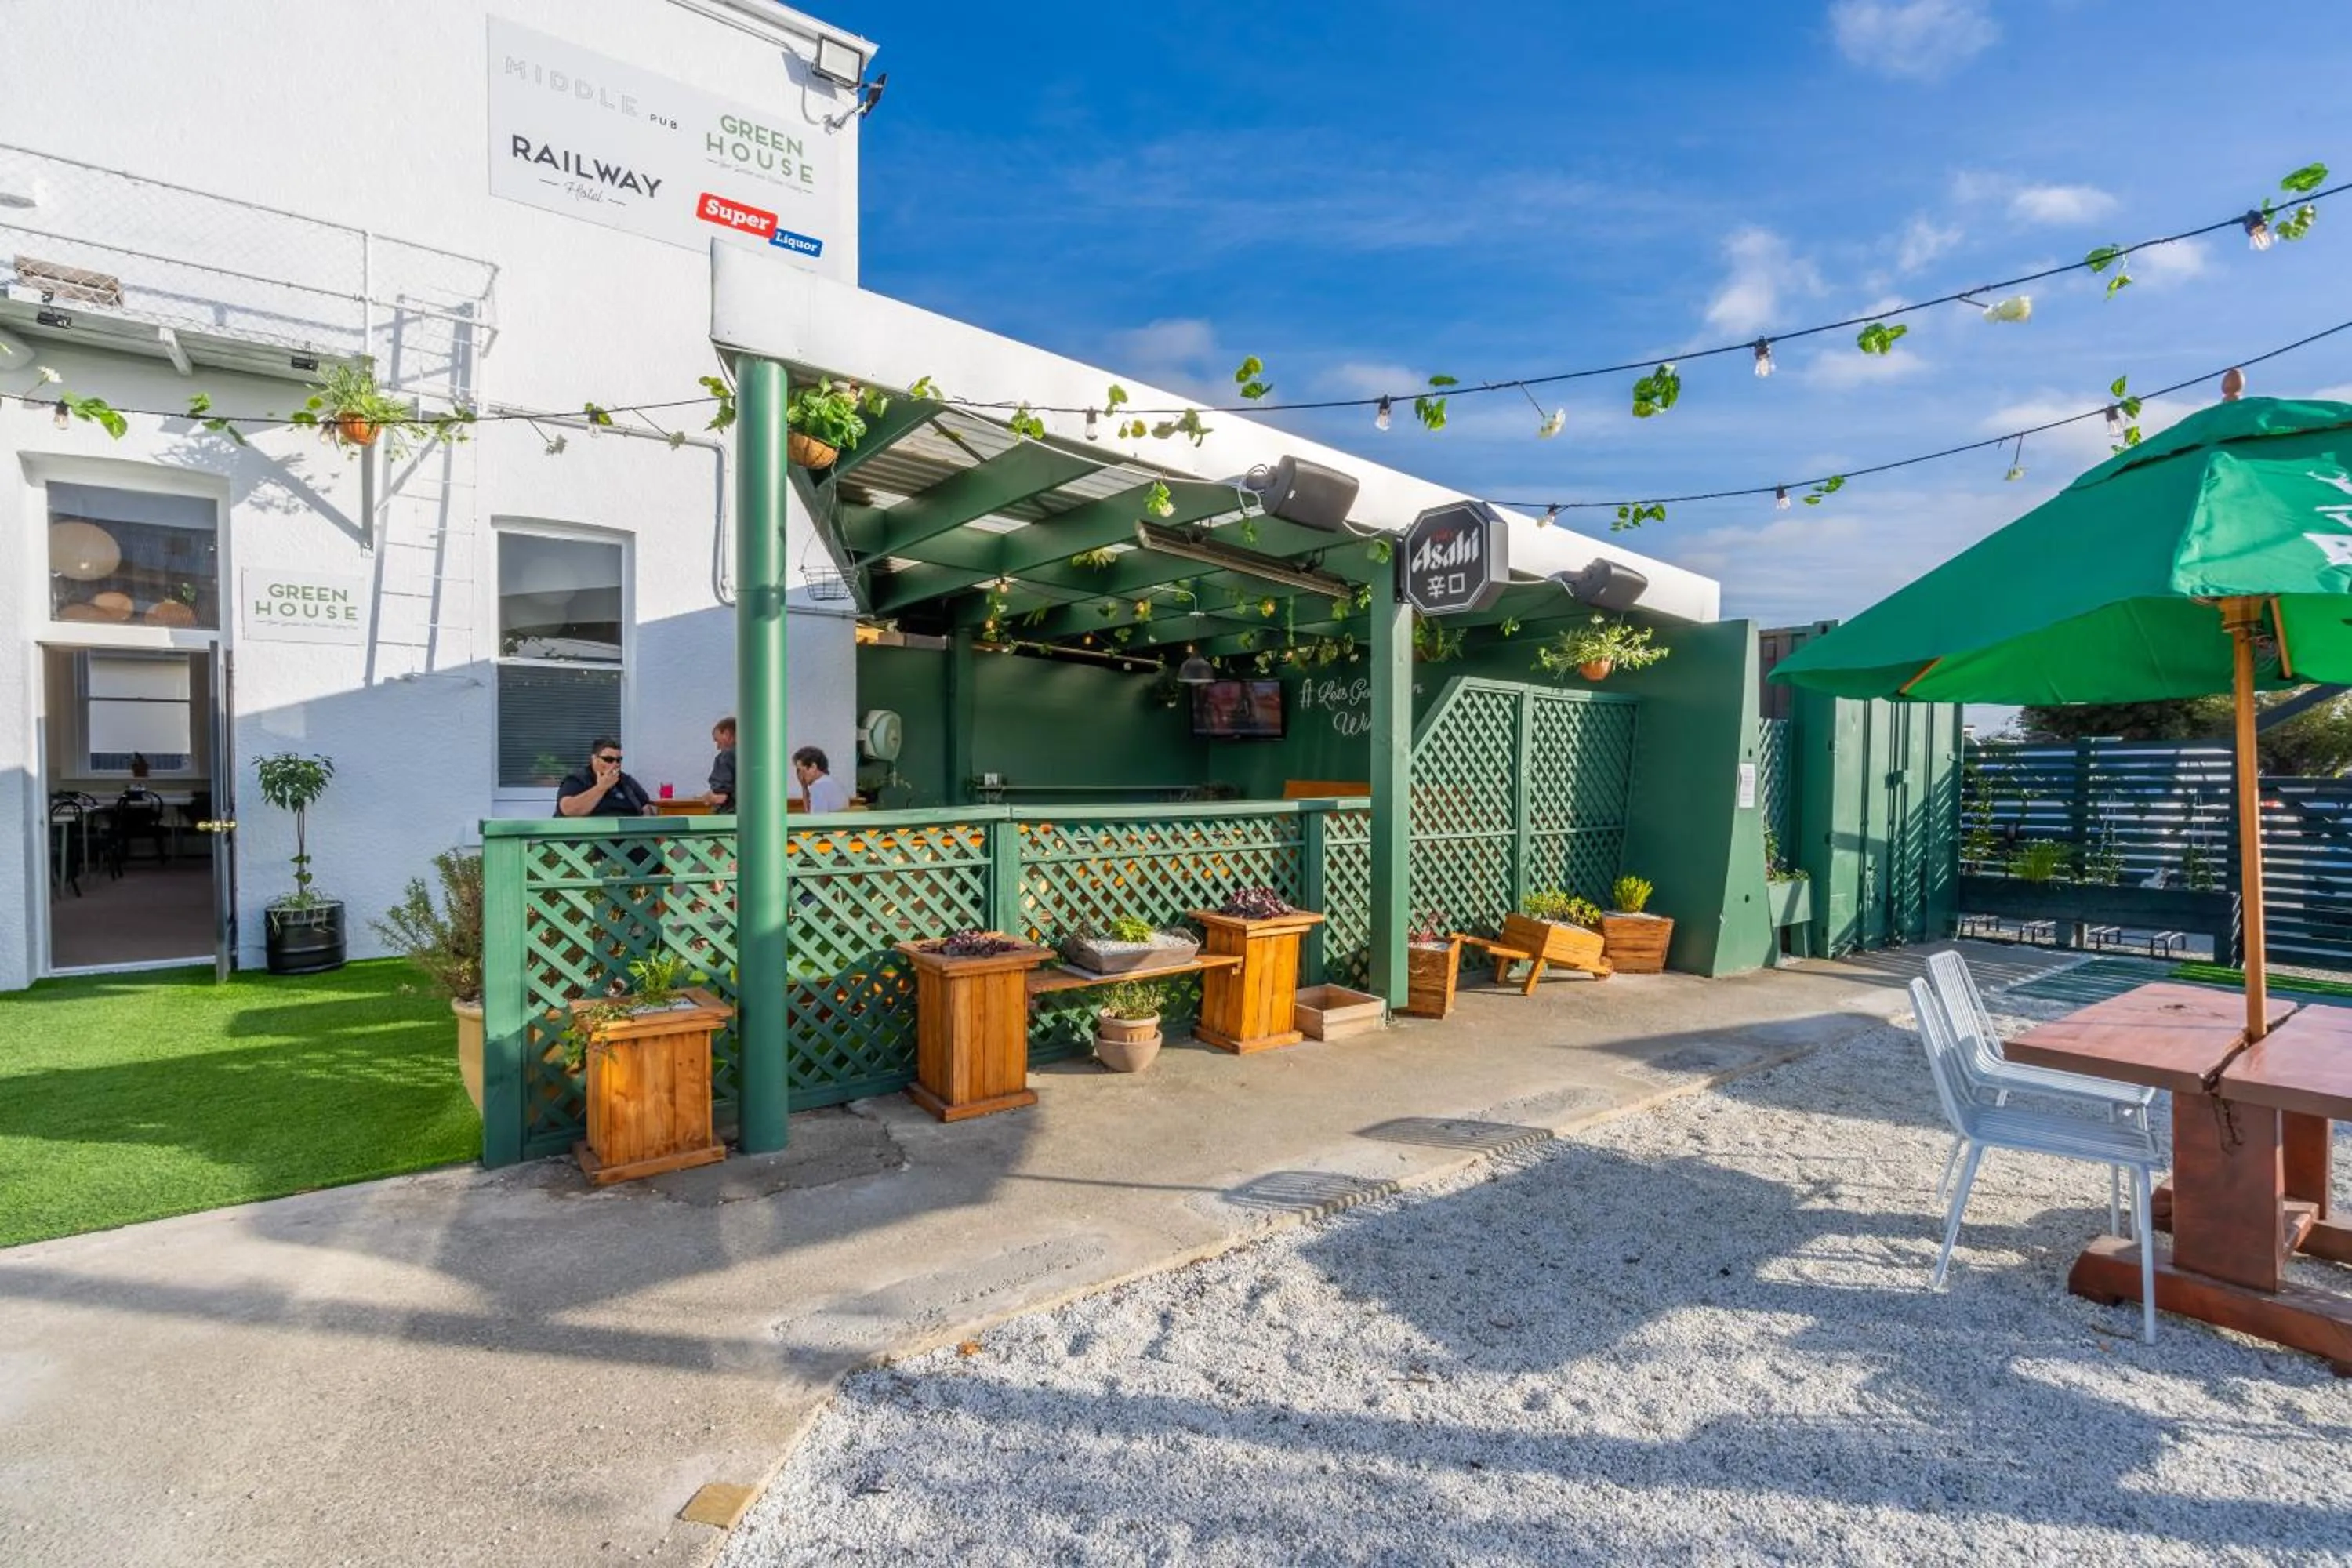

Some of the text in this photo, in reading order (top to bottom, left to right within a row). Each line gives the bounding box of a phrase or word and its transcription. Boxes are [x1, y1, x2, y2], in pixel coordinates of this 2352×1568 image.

[505, 56, 678, 129] MIDDLE PUB
[720, 114, 803, 158] GREEN
[512, 134, 661, 198] RAILWAY
[706, 132, 814, 184] HOUSE
[564, 181, 604, 204] Hotel
[706, 198, 771, 232] Super
[775, 231, 817, 252] Liquor
[1412, 527, 1479, 573] Asahi
[268, 583, 347, 602] GREEN
[1428, 572, 1465, 599] 辛口
[255, 601, 358, 620] HOUSE
